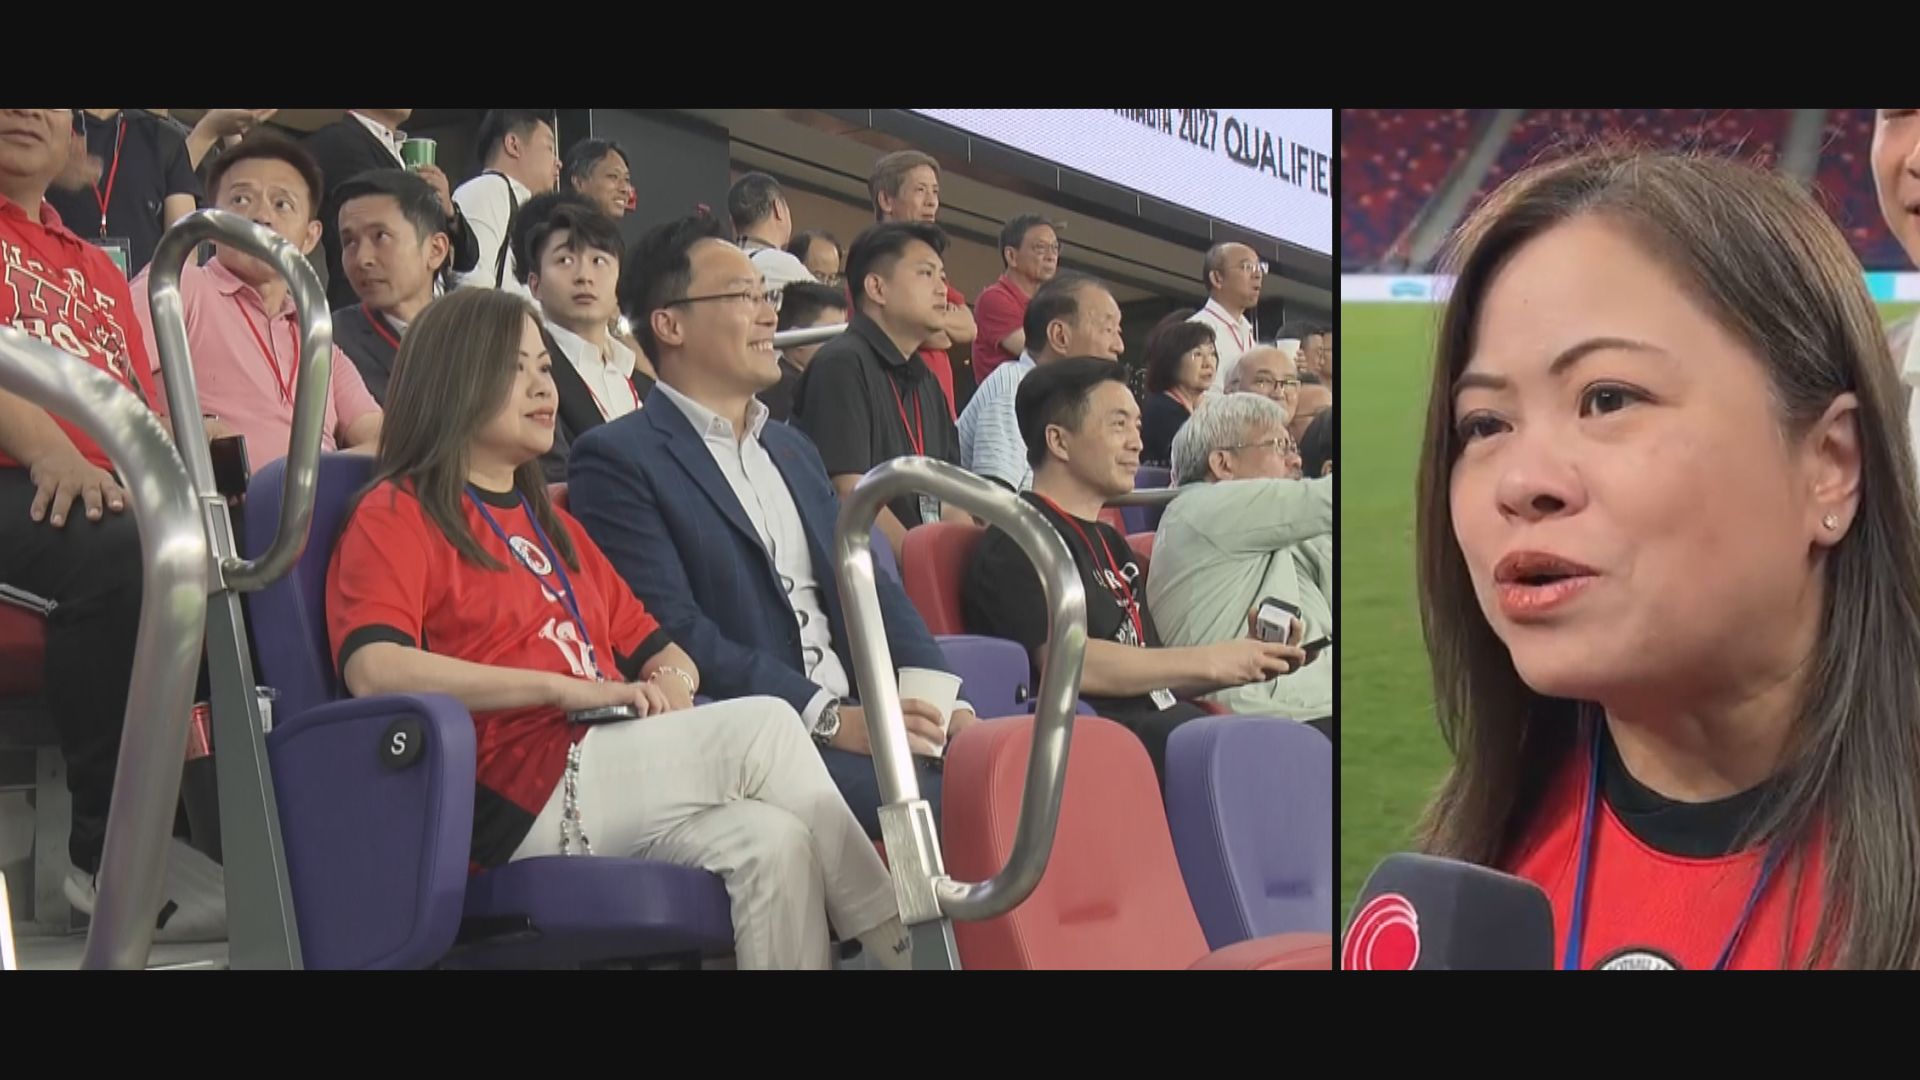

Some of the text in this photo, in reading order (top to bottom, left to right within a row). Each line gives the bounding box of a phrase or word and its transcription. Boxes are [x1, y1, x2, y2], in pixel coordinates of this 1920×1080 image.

[1178, 109, 1218, 152] 2027
[1223, 116, 1332, 198] QUALIFIE
[391, 732, 407, 755] S
